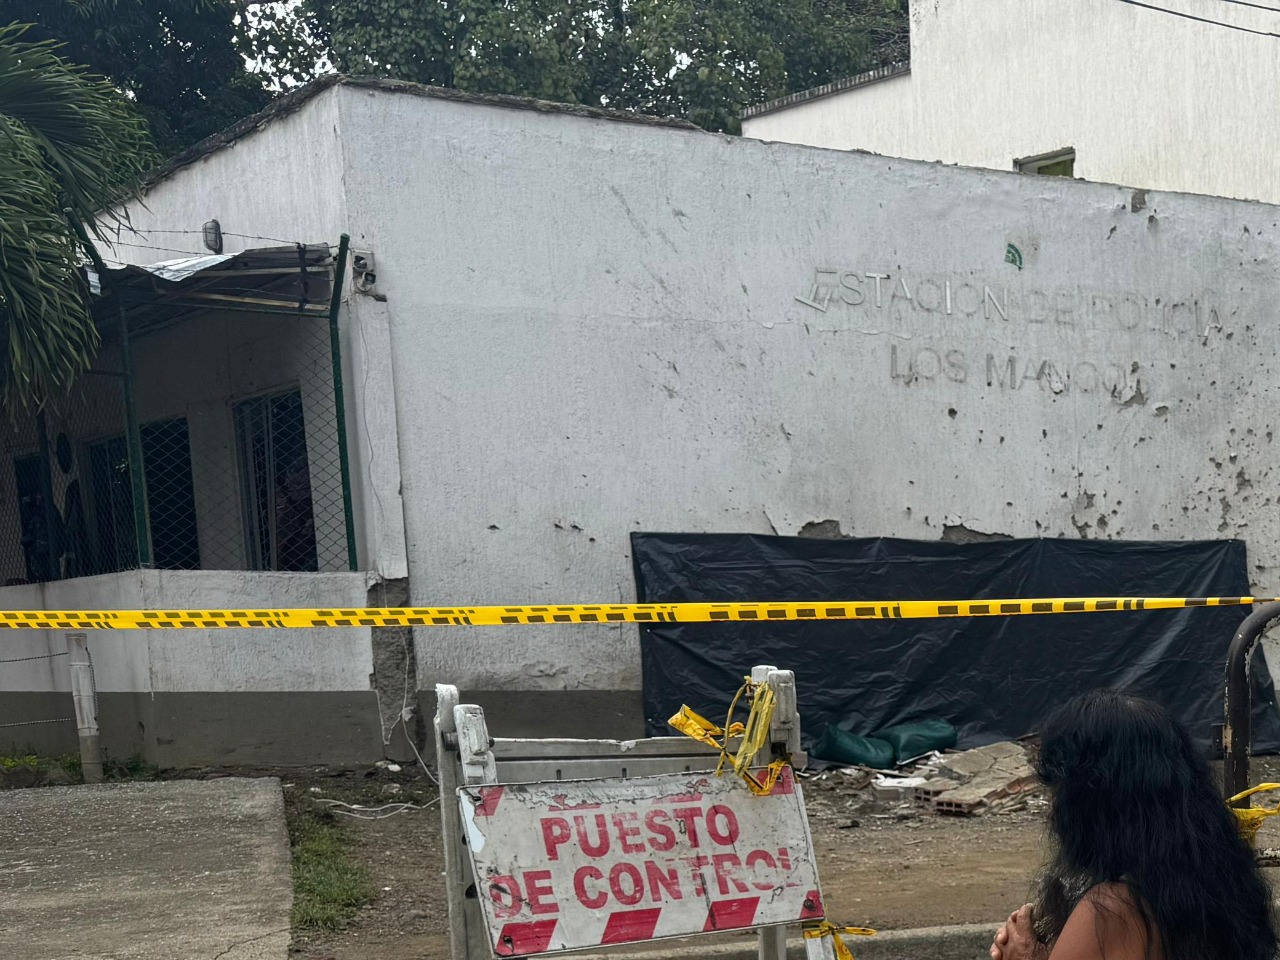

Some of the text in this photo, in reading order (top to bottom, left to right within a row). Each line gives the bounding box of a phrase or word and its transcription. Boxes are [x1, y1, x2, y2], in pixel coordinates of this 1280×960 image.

[889, 344, 968, 384] LOS
[540, 804, 740, 861] PUESTO
[489, 847, 800, 919] DE CONTROL
